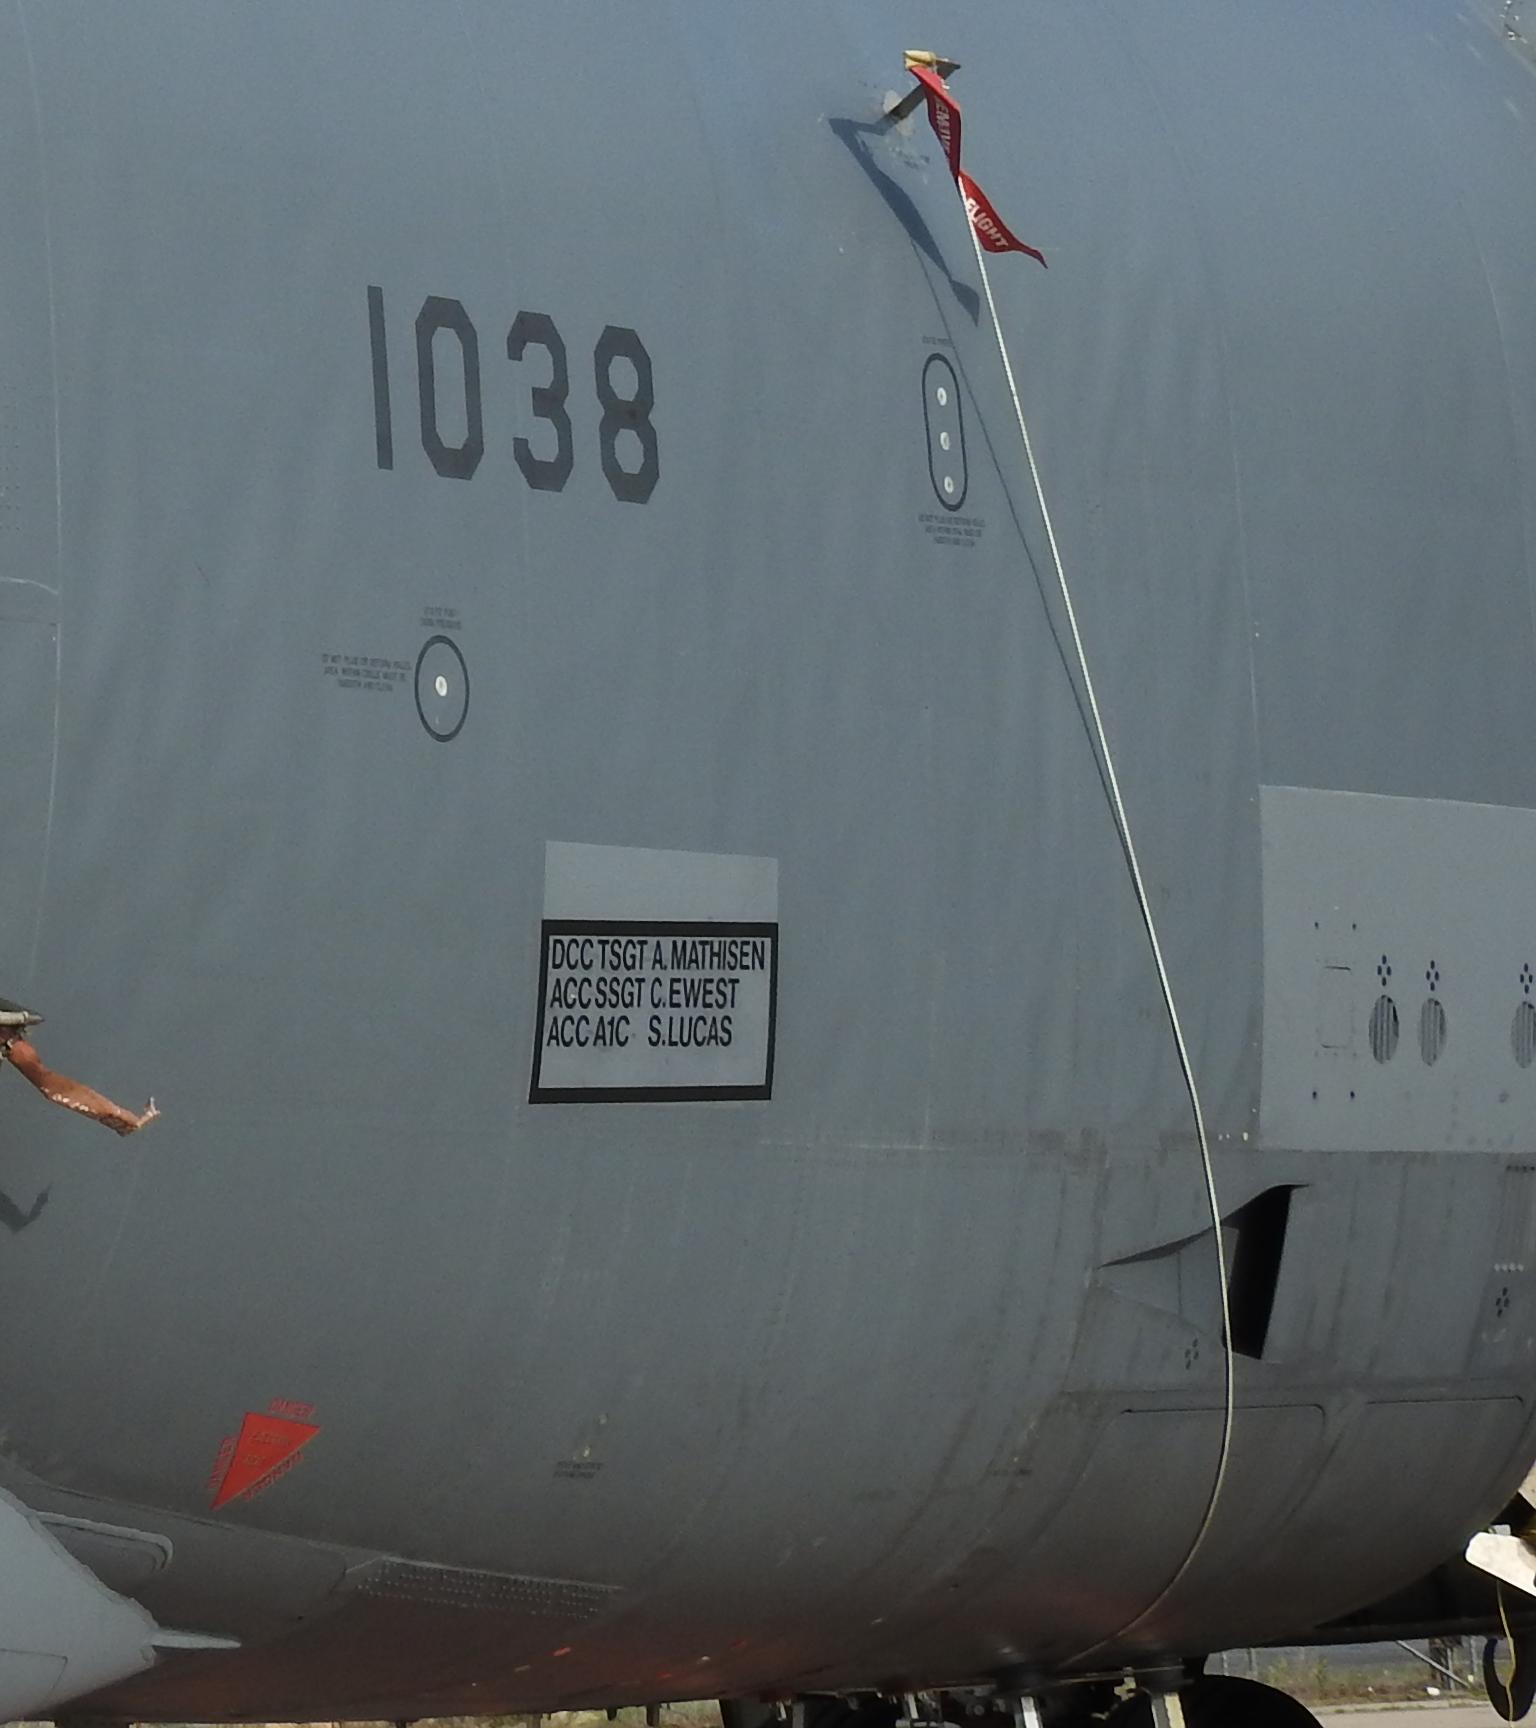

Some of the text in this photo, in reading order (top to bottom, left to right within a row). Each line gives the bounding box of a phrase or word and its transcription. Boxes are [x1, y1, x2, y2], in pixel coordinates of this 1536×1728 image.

[367, 284, 660, 505] 1038
[551, 938, 593, 970] DCC
[597, 938, 648, 971] TSGT
[549, 976, 592, 1009] ACC
[594, 976, 646, 1009] SSGT
[546, 1015, 590, 1047] ACC
